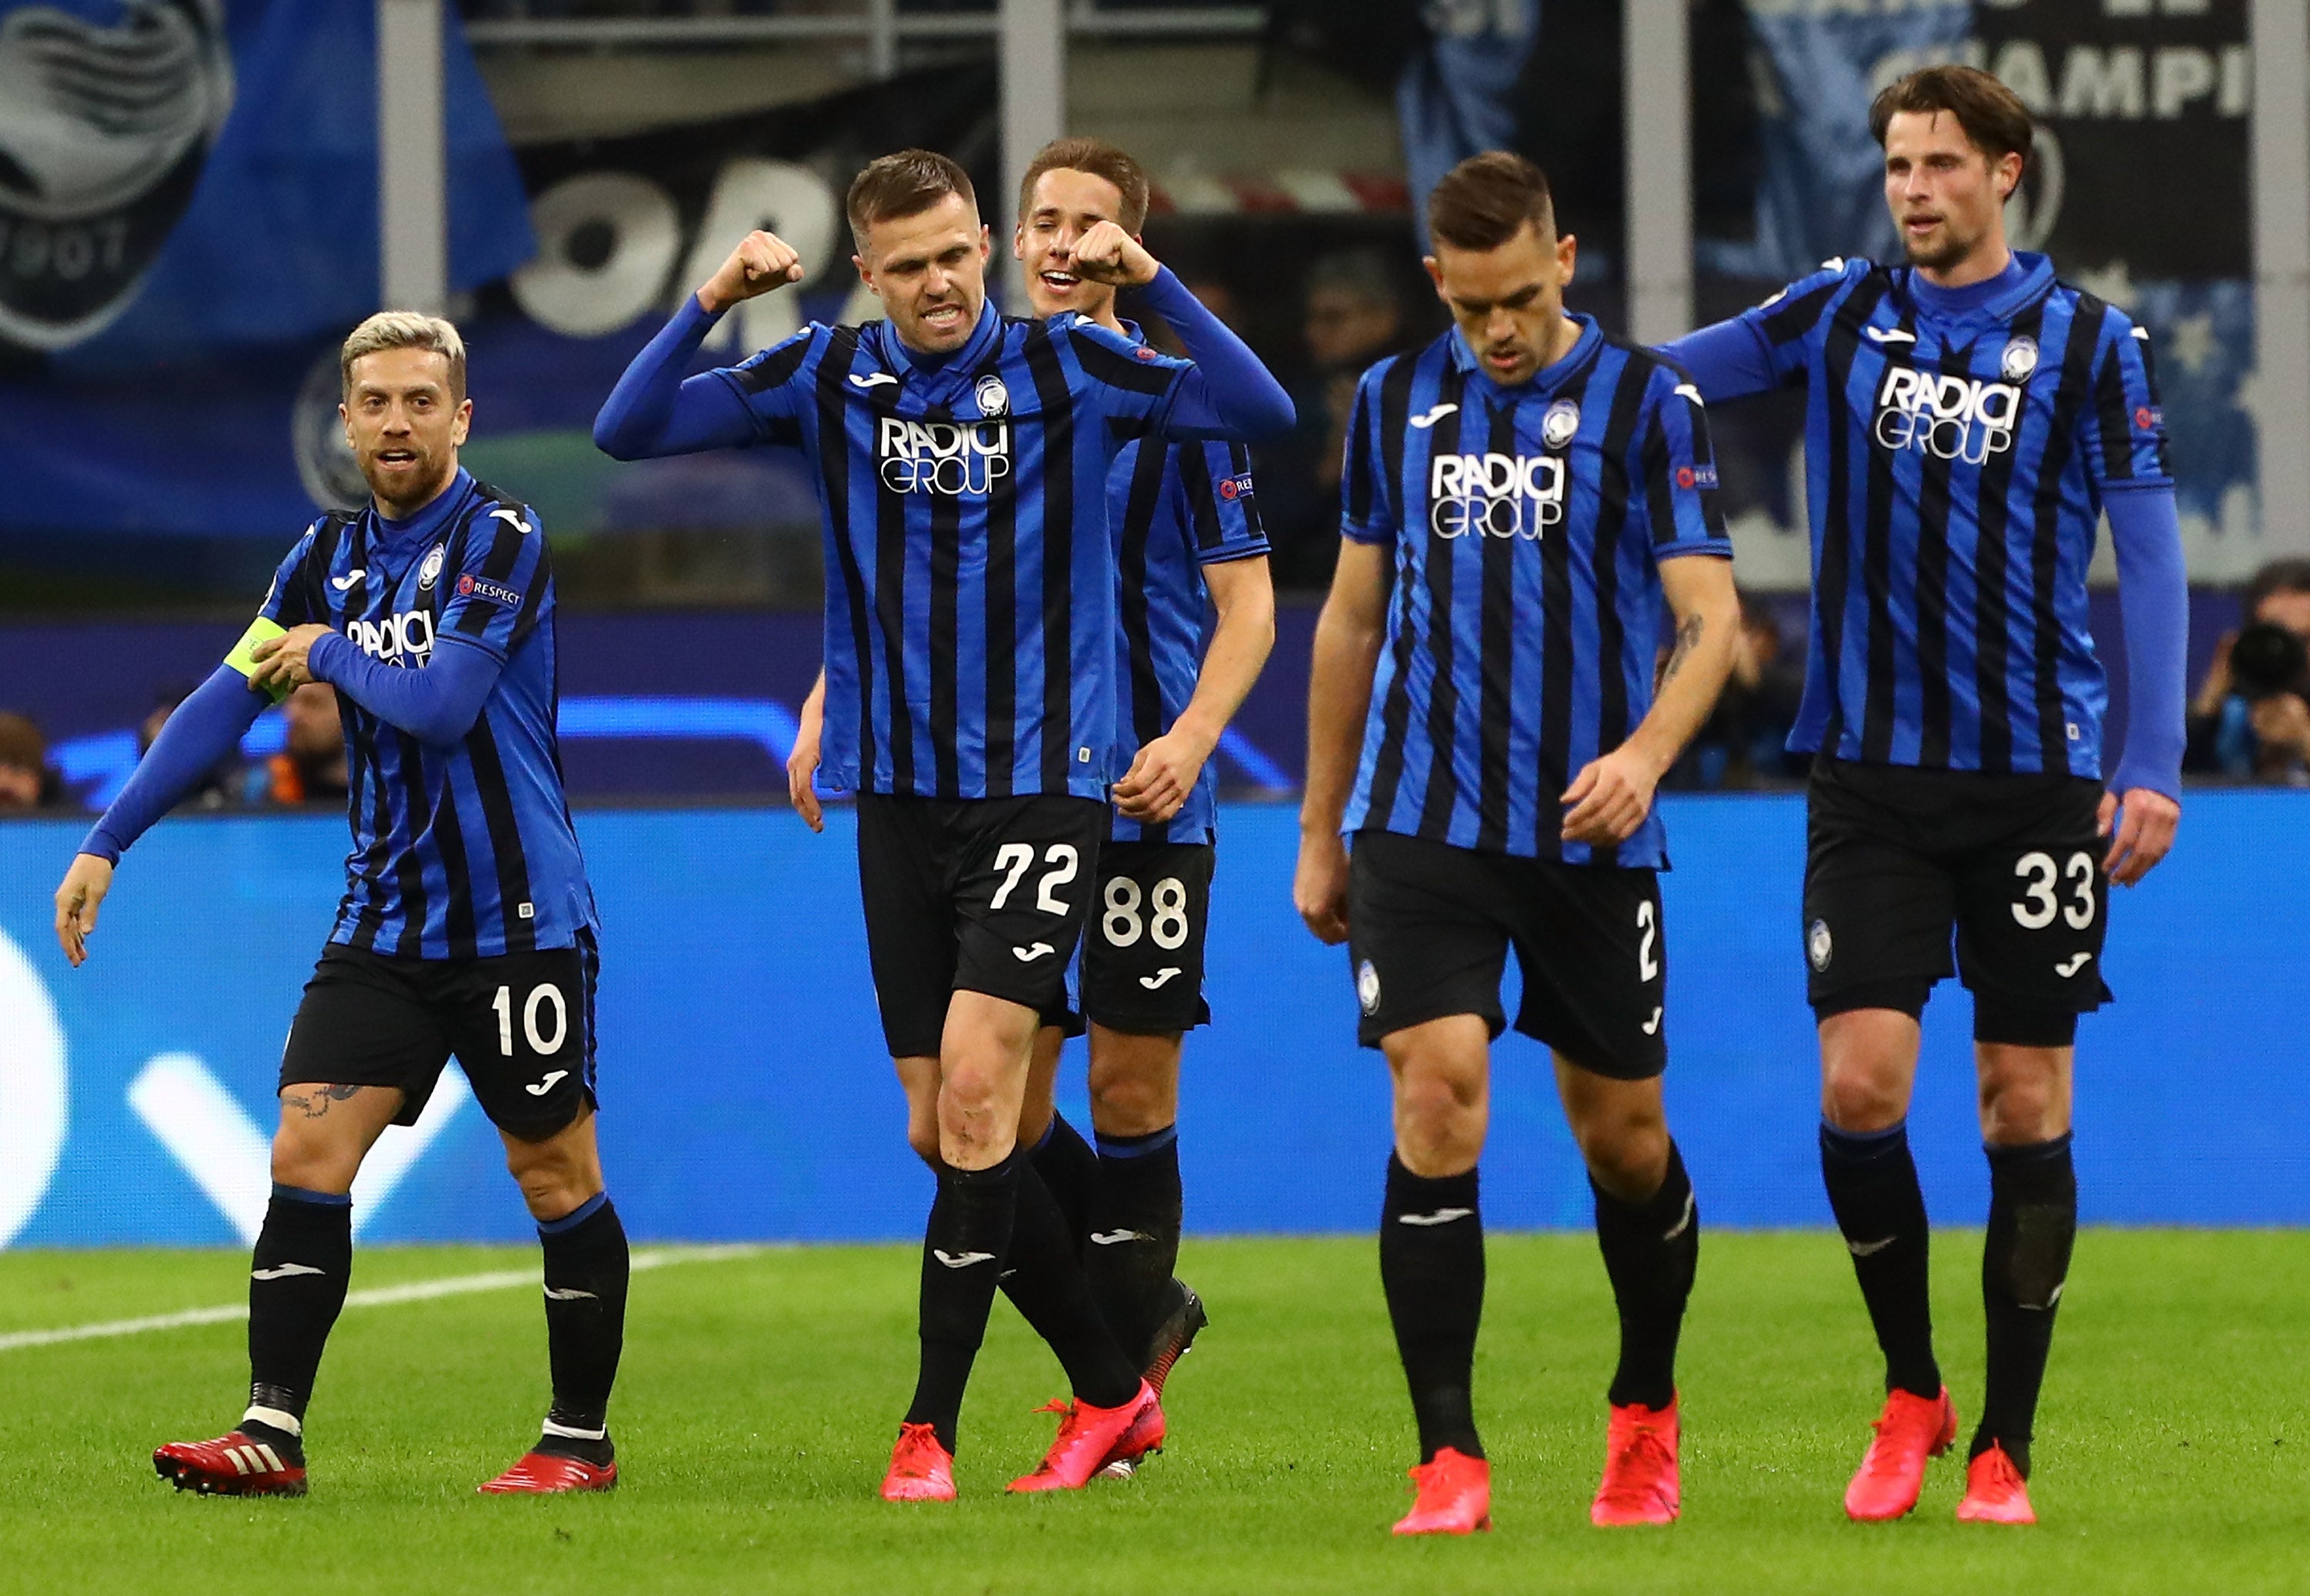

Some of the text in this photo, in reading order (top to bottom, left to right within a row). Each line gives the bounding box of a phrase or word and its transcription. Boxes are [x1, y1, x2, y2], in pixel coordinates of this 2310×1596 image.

[1870, 38, 2252, 119] AMPI
[1880, 366, 2020, 430] RADICI
[881, 417, 1008, 459] RADICI
[1876, 407, 2010, 466] GROUP
[880, 456, 1009, 494] GROUP
[1431, 453, 1565, 502] RADICI
[1431, 495, 1562, 540] GROUP
[474, 582, 520, 605] RESPECT
[346, 610, 435, 660] RADICI
[989, 843, 1078, 916] 72
[2011, 852, 2096, 930] 33
[1103, 876, 1189, 950] 88
[1637, 900, 1659, 983] 2
[492, 983, 567, 1056] 10
